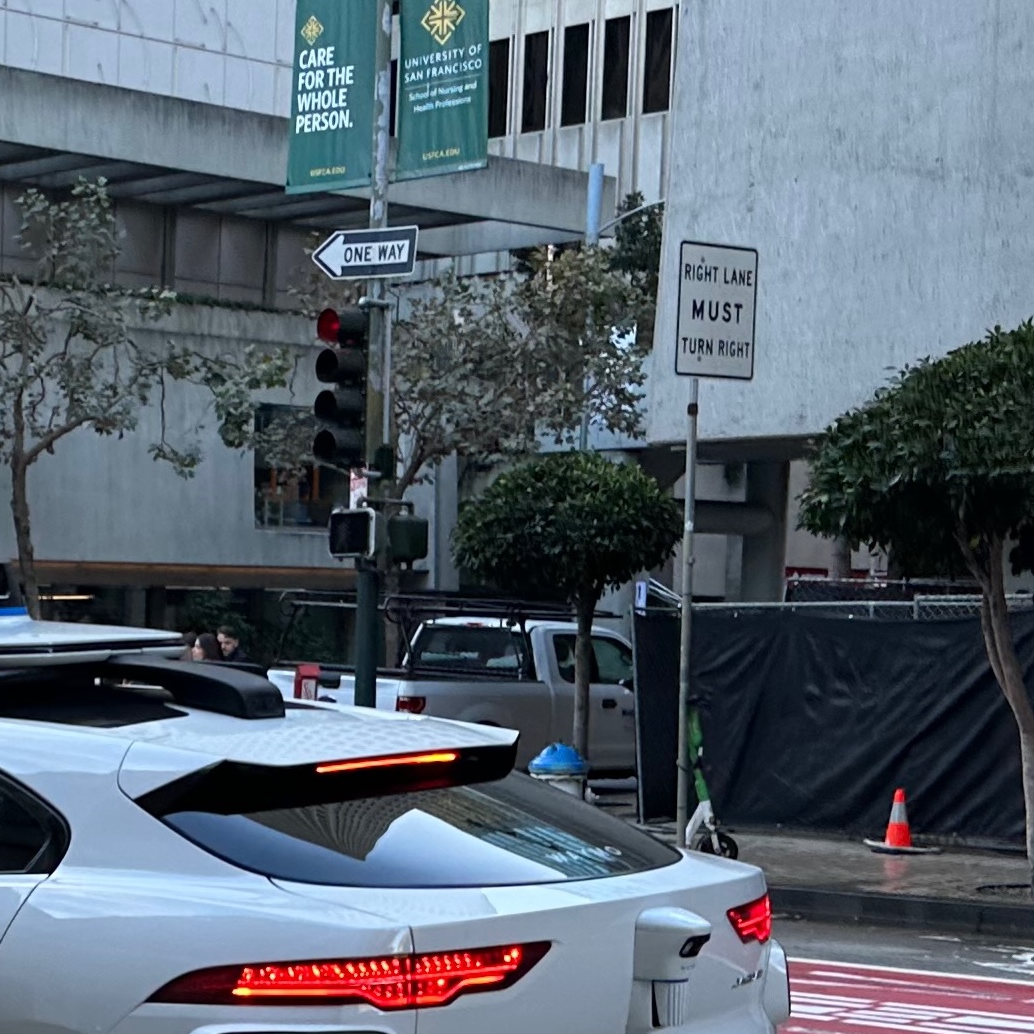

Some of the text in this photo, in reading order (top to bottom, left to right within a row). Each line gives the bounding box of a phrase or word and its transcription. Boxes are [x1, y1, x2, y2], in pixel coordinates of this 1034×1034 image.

[299, 47, 335, 69] CARE
[404, 44, 482, 69] UNIVERSITY OF
[298, 66, 354, 91] FOR THE
[404, 59, 482, 83] SAN FRANCISCO
[297, 89, 347, 112] WHOLE
[296, 110, 353, 134] PERSON.
[344, 243, 405, 263] ONE WAY
[684, 264, 753, 287] RIGHT LANE
[692, 299, 743, 324] MUST
[682, 337, 750, 359] TURN RIGHT
